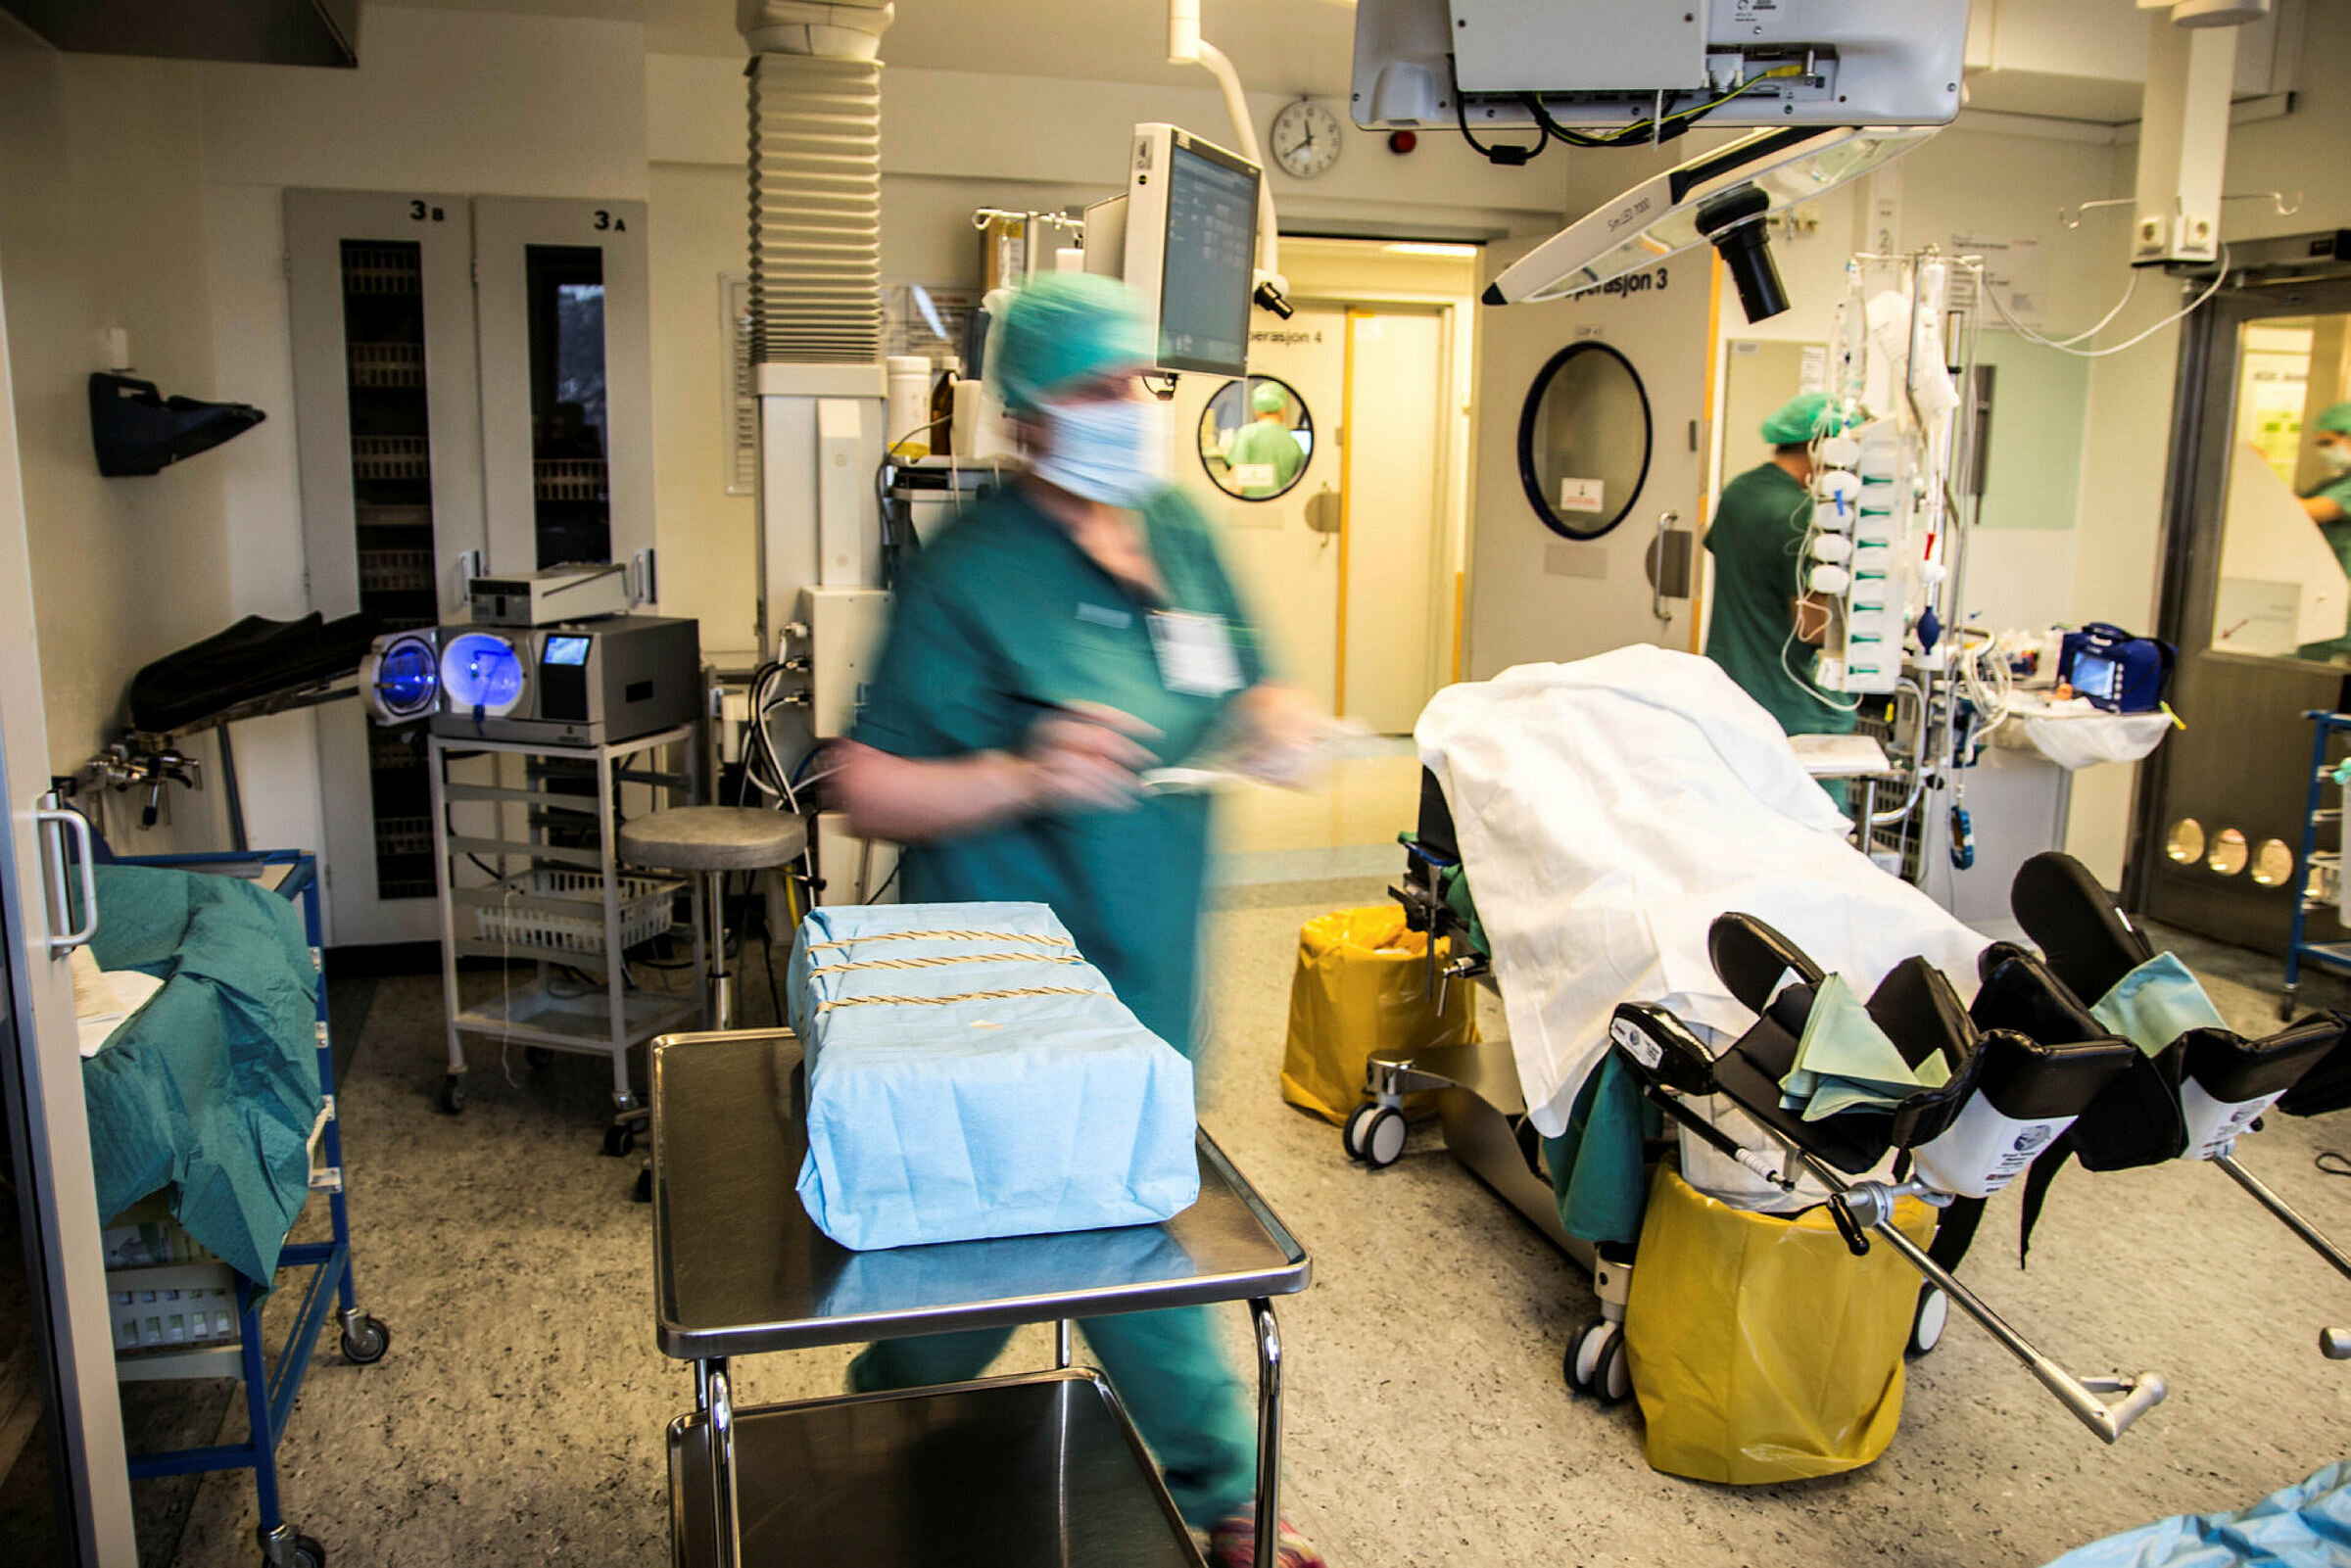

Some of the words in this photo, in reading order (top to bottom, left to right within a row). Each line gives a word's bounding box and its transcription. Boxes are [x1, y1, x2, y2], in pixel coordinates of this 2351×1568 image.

[409, 200, 426, 220] 3
[594, 210, 609, 230] 3
[1656, 267, 1668, 290] 3
[1314, 330, 1322, 344] 4
